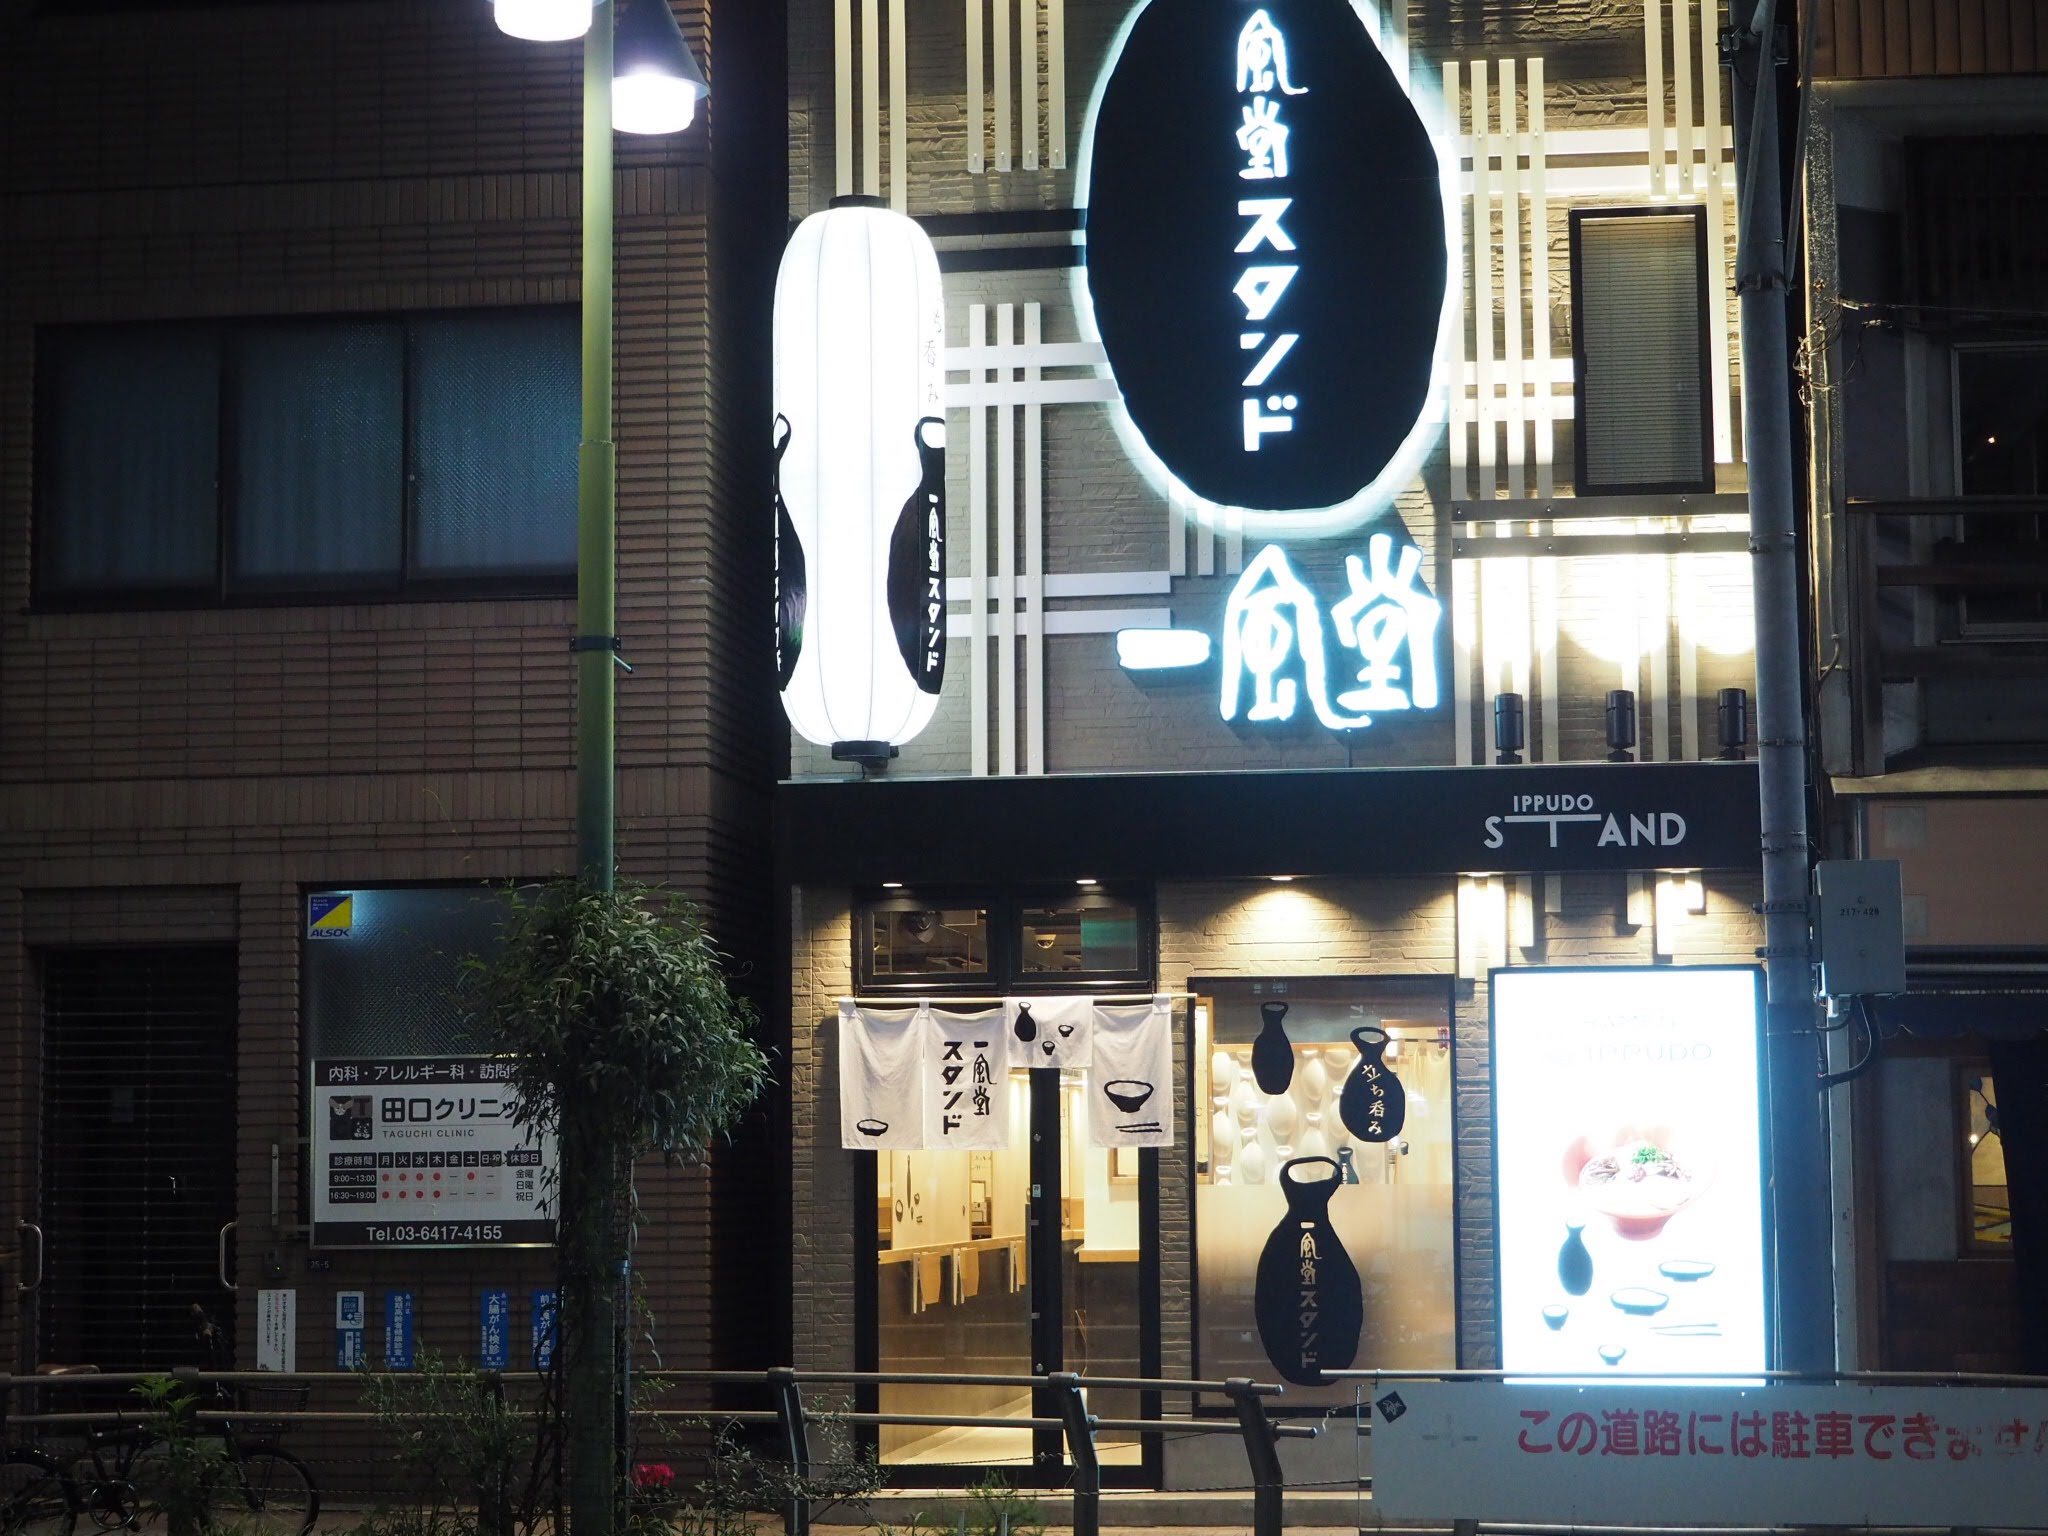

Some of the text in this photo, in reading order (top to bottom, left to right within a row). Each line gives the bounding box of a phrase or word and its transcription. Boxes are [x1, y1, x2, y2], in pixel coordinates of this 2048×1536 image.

[927, 494, 943, 672] 一風堂スタンド
[1116, 533, 1443, 730] 一風堂
[1513, 794, 1594, 812] IPPUDO
[1484, 812, 1686, 849] STAND
[310, 928, 349, 938] ALSOK
[972, 1041, 997, 1115] 一風堂
[941, 1041, 964, 1135] スタンド
[1362, 1065, 1386, 1135] 立ち呑み
[383, 1129, 475, 1138] TAGUCHI CLINIC
[333, 1154, 373, 1166] 診療時間
[381, 1155, 391, 1166] 月
[398, 1155, 408, 1165] 火
[415, 1154, 425, 1165] 水
[432, 1154, 442, 1165] 木
[449, 1154, 459, 1165] 金
[466, 1154, 476, 1165] 土
[510, 1153, 540, 1164] 休診日
[516, 1169, 534, 1179] 金曜
[516, 1181, 534, 1190] 日曜
[516, 1191, 534, 1201] 祝日
[366, 1226, 503, 1241] Tel.03-6417-4155
[1299, 1221, 1323, 1368] 一風堂スタンド
